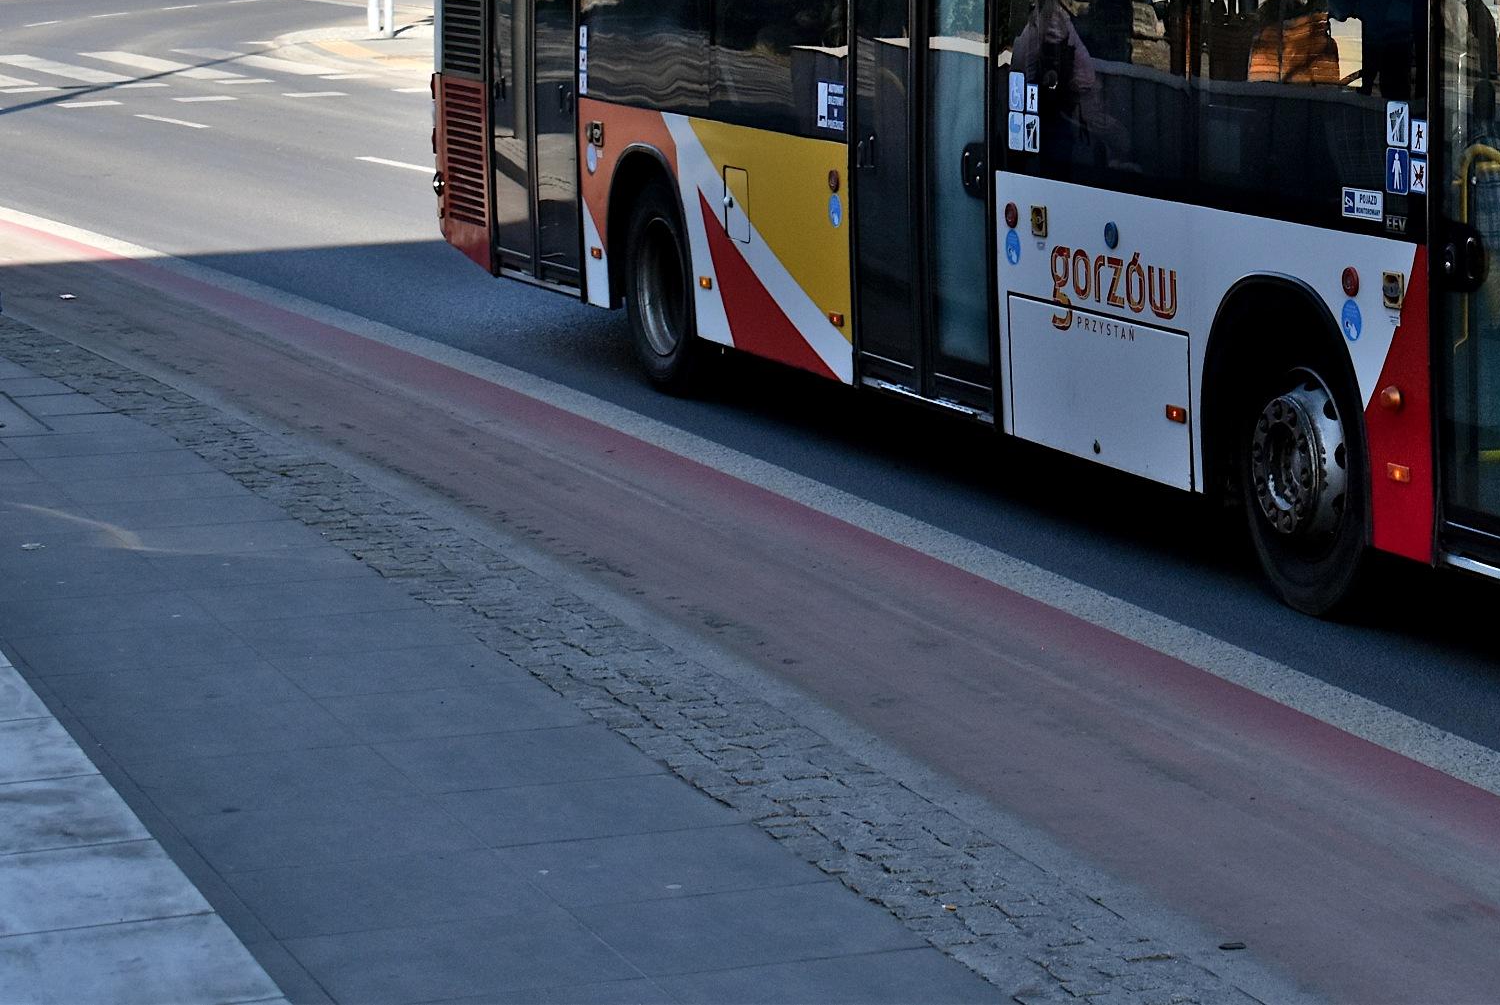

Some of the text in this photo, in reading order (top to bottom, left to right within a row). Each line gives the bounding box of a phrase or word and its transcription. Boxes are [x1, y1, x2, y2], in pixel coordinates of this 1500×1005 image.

[1359, 193, 1378, 206] POJAZD
[1386, 217, 1406, 232] EEV
[1050, 245, 1178, 331] gorzów
[1077, 316, 1135, 342] PRZYSTAŃ
